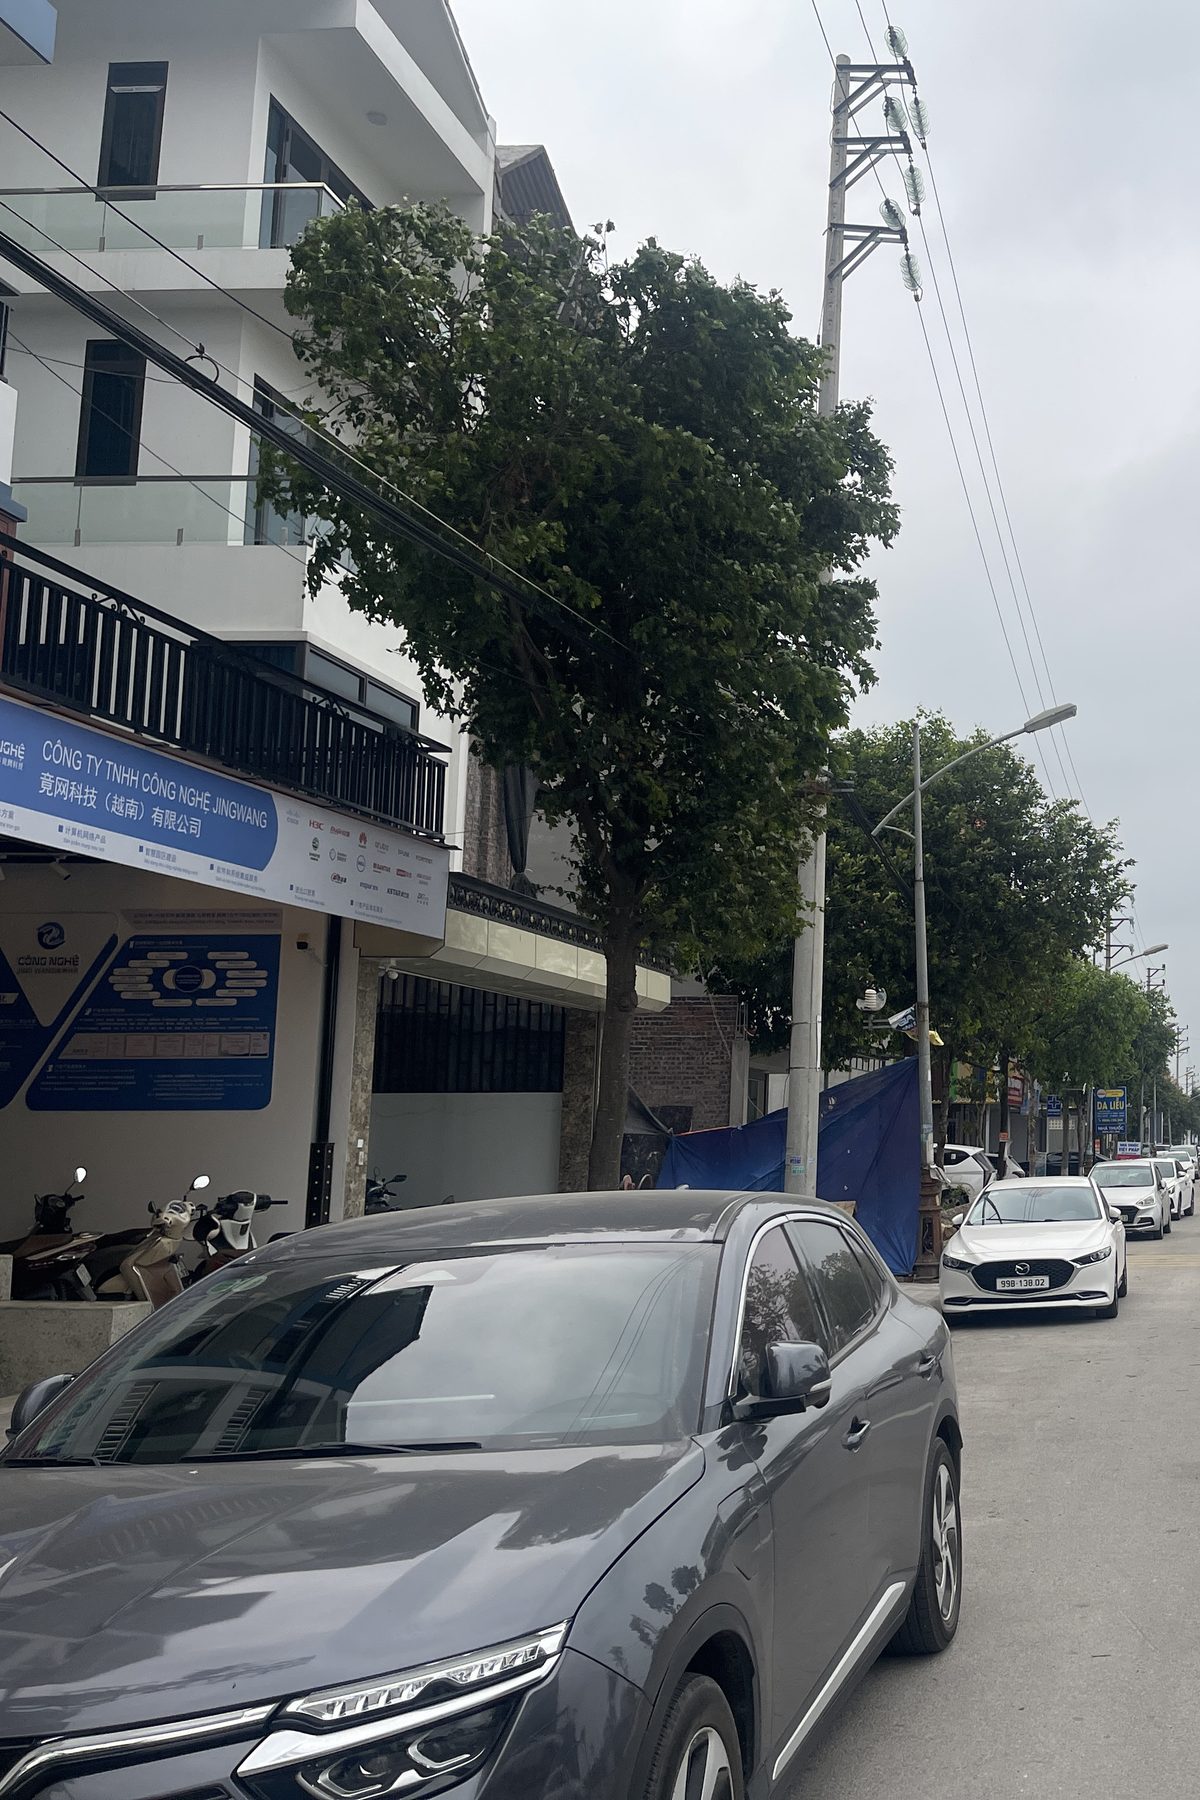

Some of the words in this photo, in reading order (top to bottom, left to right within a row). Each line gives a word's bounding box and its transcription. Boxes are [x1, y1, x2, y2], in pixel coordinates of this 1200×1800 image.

[43, 739, 82, 770] CÔNG
[86, 754, 103, 776] TY
[106, 760, 140, 789] TNHH
[142, 772, 176, 800] CÔNG
[179, 785, 211, 815] NGHỆ
[213, 797, 267, 829] JINGWANG
[309, 819, 324, 831] H3C
[1097, 1101, 1107, 1110] DA
